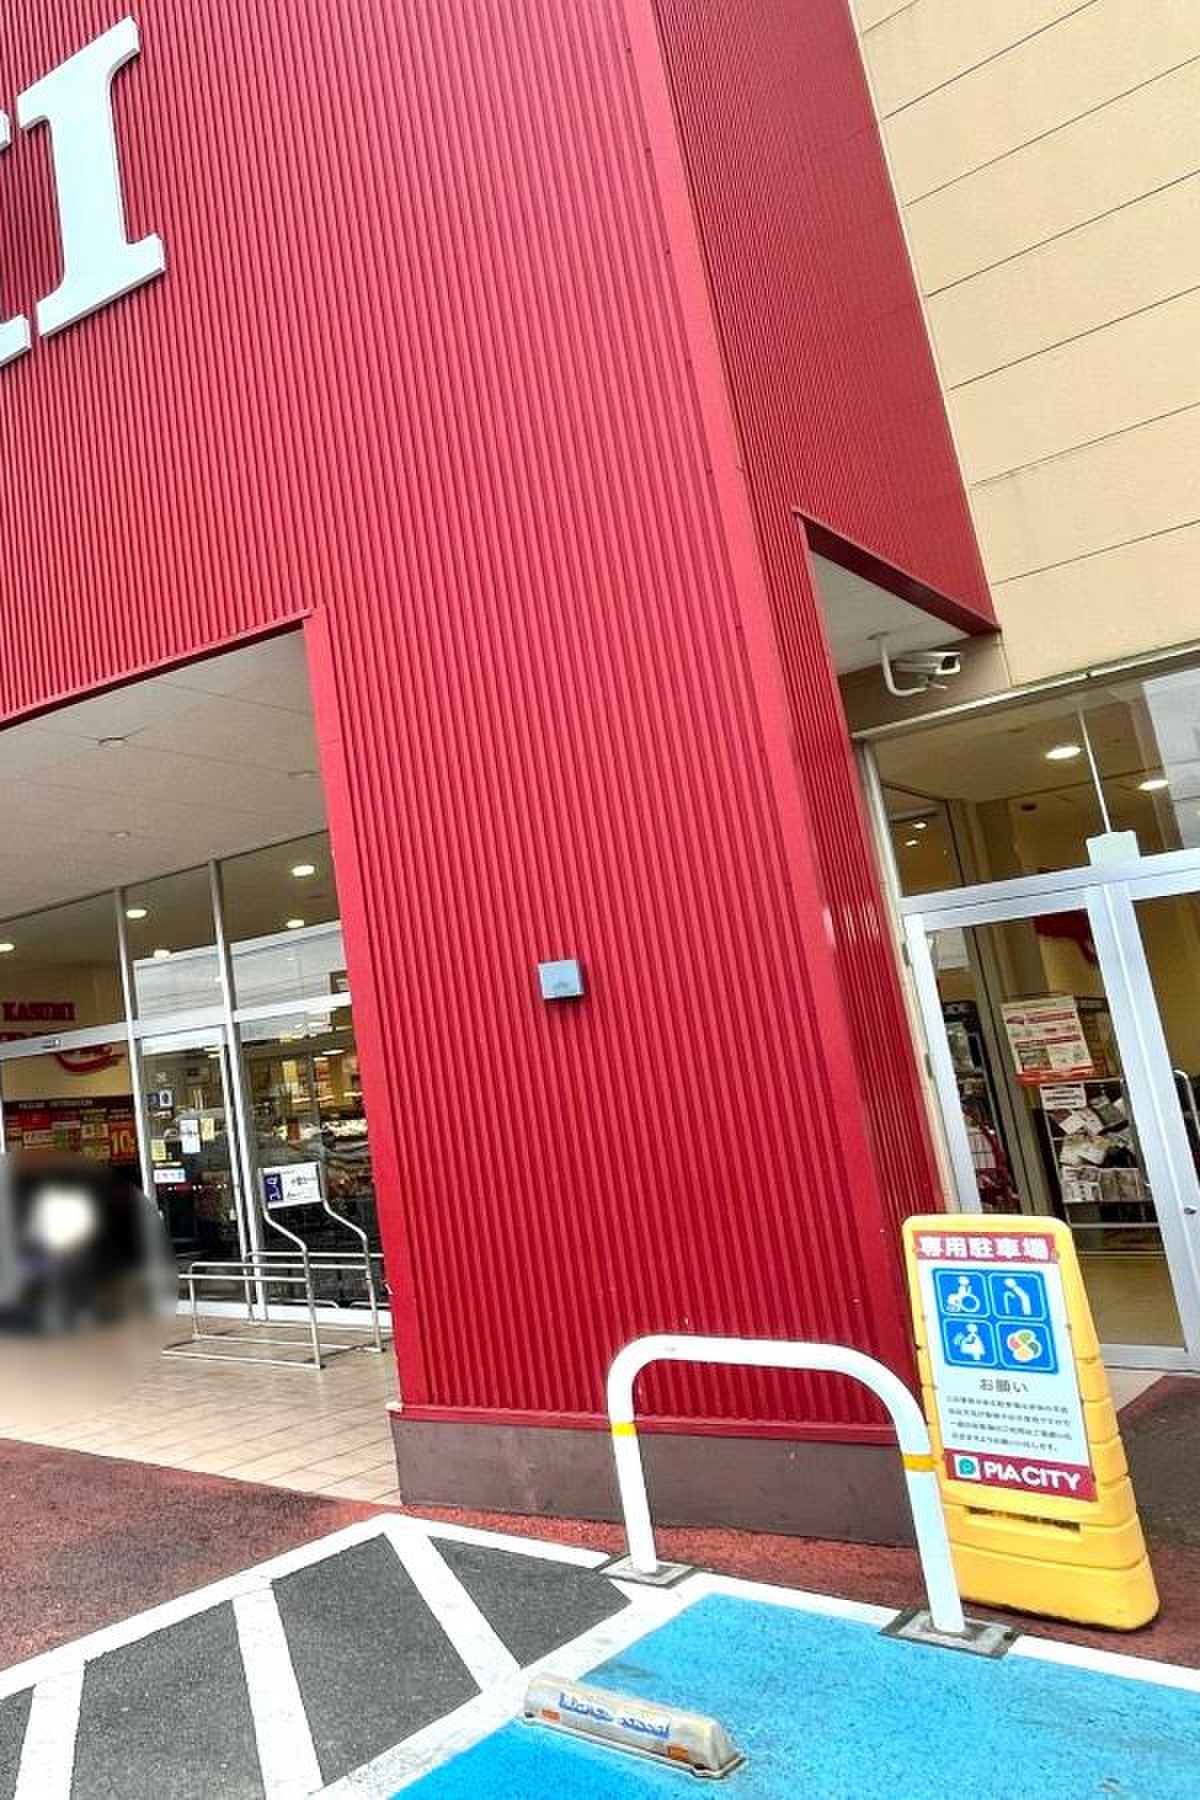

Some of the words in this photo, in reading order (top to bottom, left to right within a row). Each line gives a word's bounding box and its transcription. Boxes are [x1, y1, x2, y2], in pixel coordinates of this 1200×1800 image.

[919, 1236, 1050, 1259] 専用駐車場
[979, 1378, 1029, 1393] お願い
